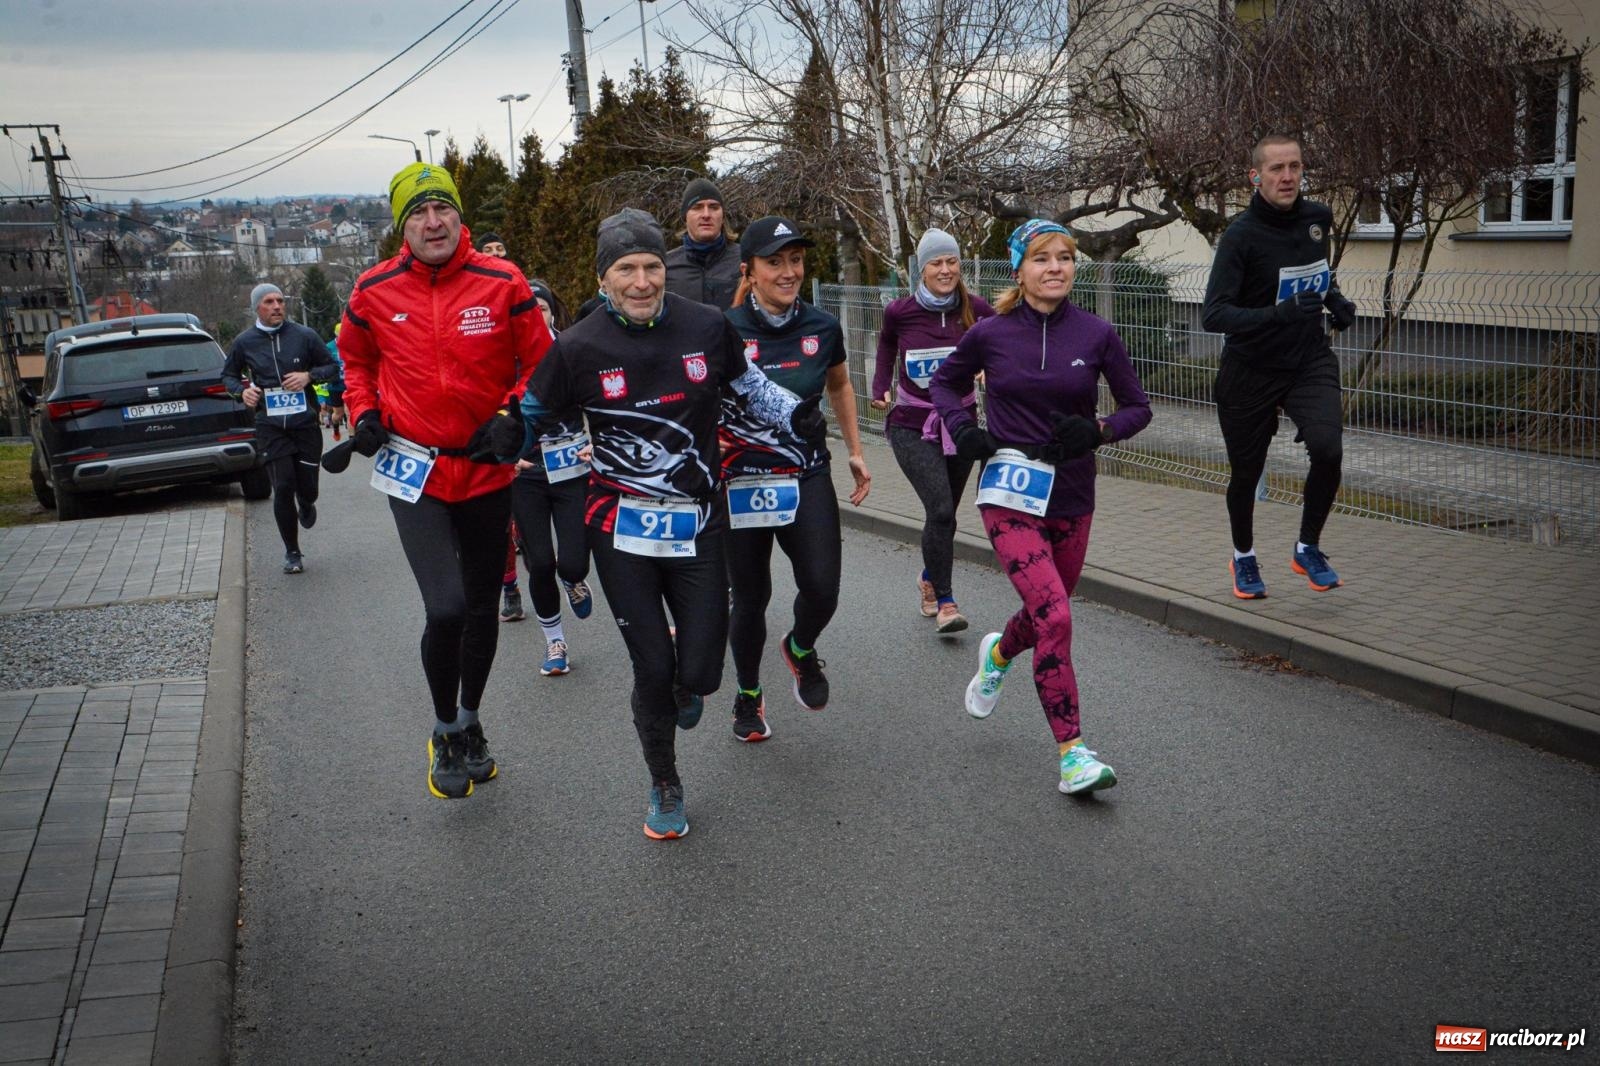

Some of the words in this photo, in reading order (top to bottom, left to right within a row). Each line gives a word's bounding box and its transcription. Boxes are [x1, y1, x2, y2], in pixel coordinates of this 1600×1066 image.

[1290, 274, 1323, 294] 179
[464, 309, 484, 318] BTS
[130, 407, 145, 417] OP
[151, 401, 185, 415] 1239P
[273, 394, 300, 408] 196
[376, 448, 418, 481] 219
[555, 443, 586, 468] 19
[995, 464, 1031, 492] 10
[749, 488, 779, 511] 68
[640, 511, 675, 538] 91
